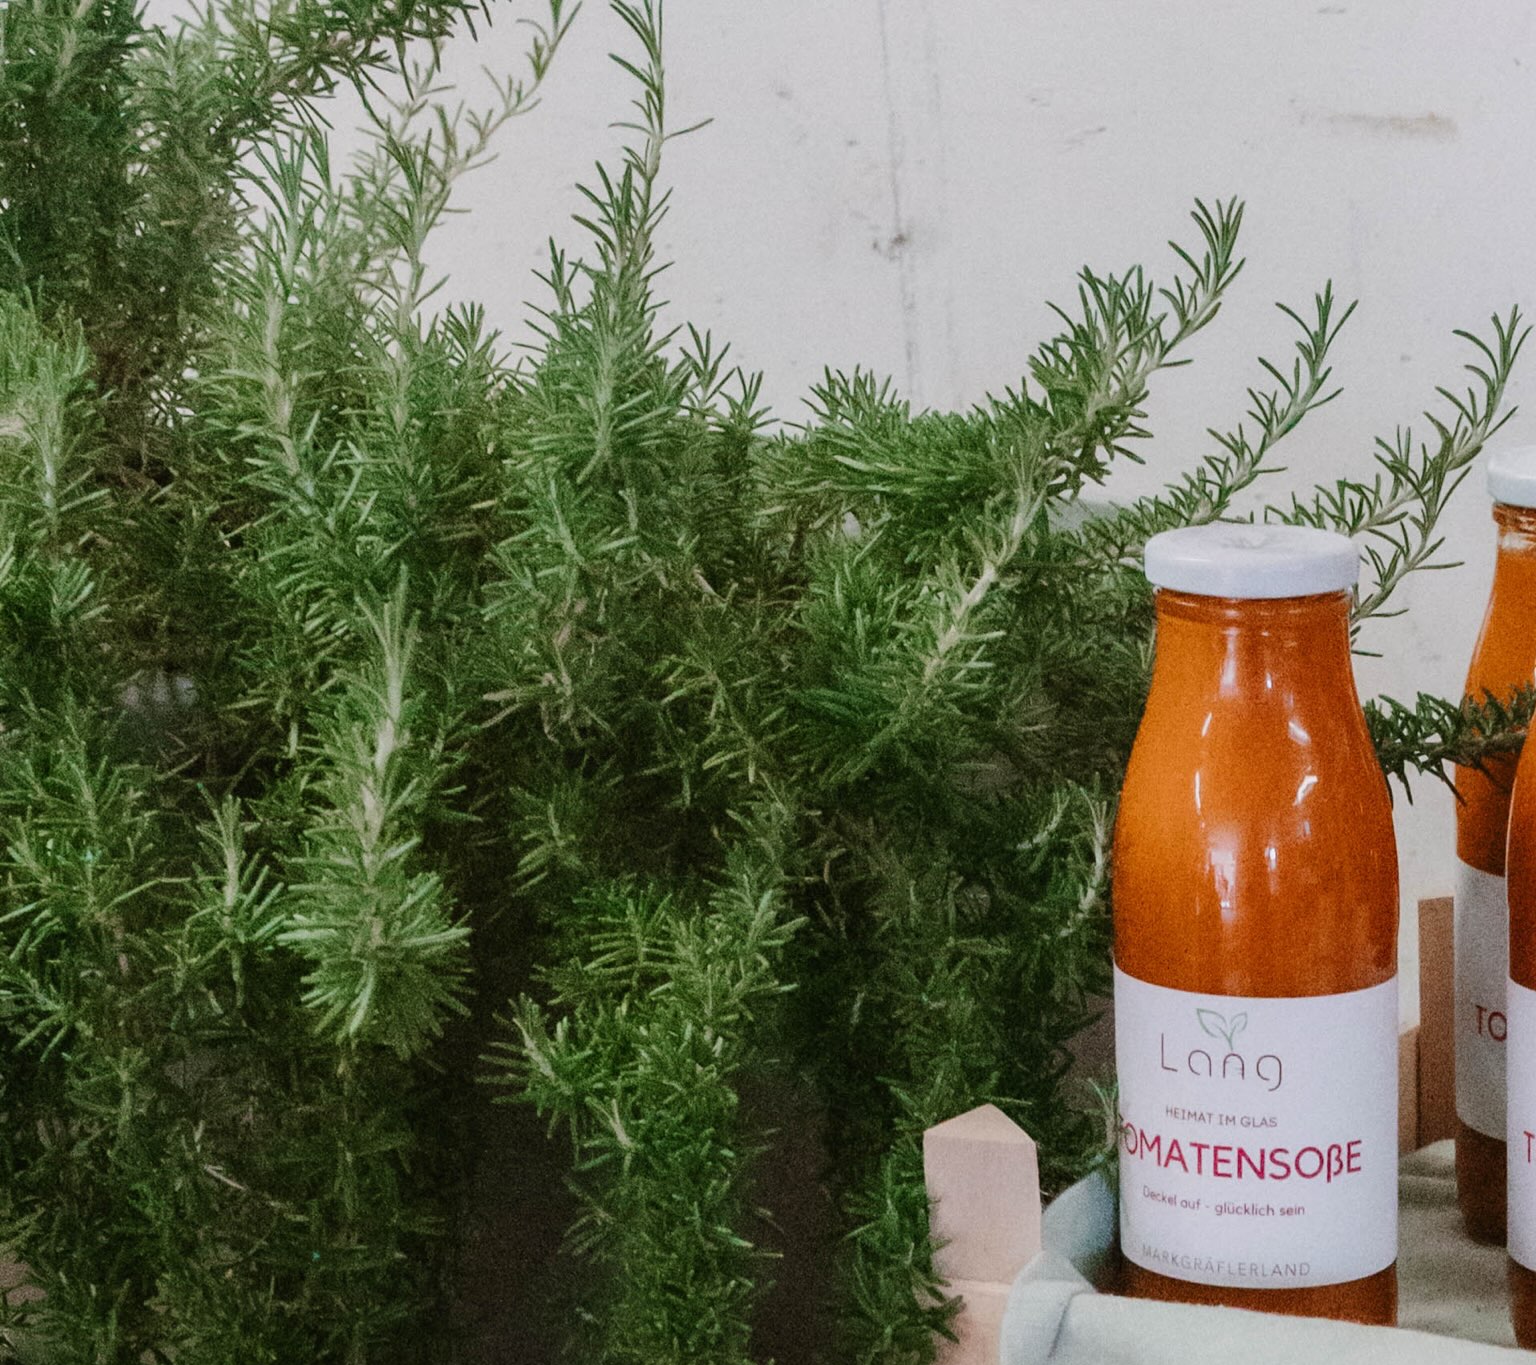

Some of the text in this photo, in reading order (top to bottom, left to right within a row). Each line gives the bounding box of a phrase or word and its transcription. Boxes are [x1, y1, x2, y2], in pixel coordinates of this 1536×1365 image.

[1161, 1032, 1283, 1092] Lang
[1165, 1105, 1278, 1128] HEIMAT IM GLAS
[1118, 1114, 1362, 1183] OMATENSOßE
[1143, 1185, 1177, 1207] Deckel
[1180, 1199, 1201, 1210] auf
[1215, 1201, 1275, 1217] glücklich
[1280, 1204, 1305, 1216] sein
